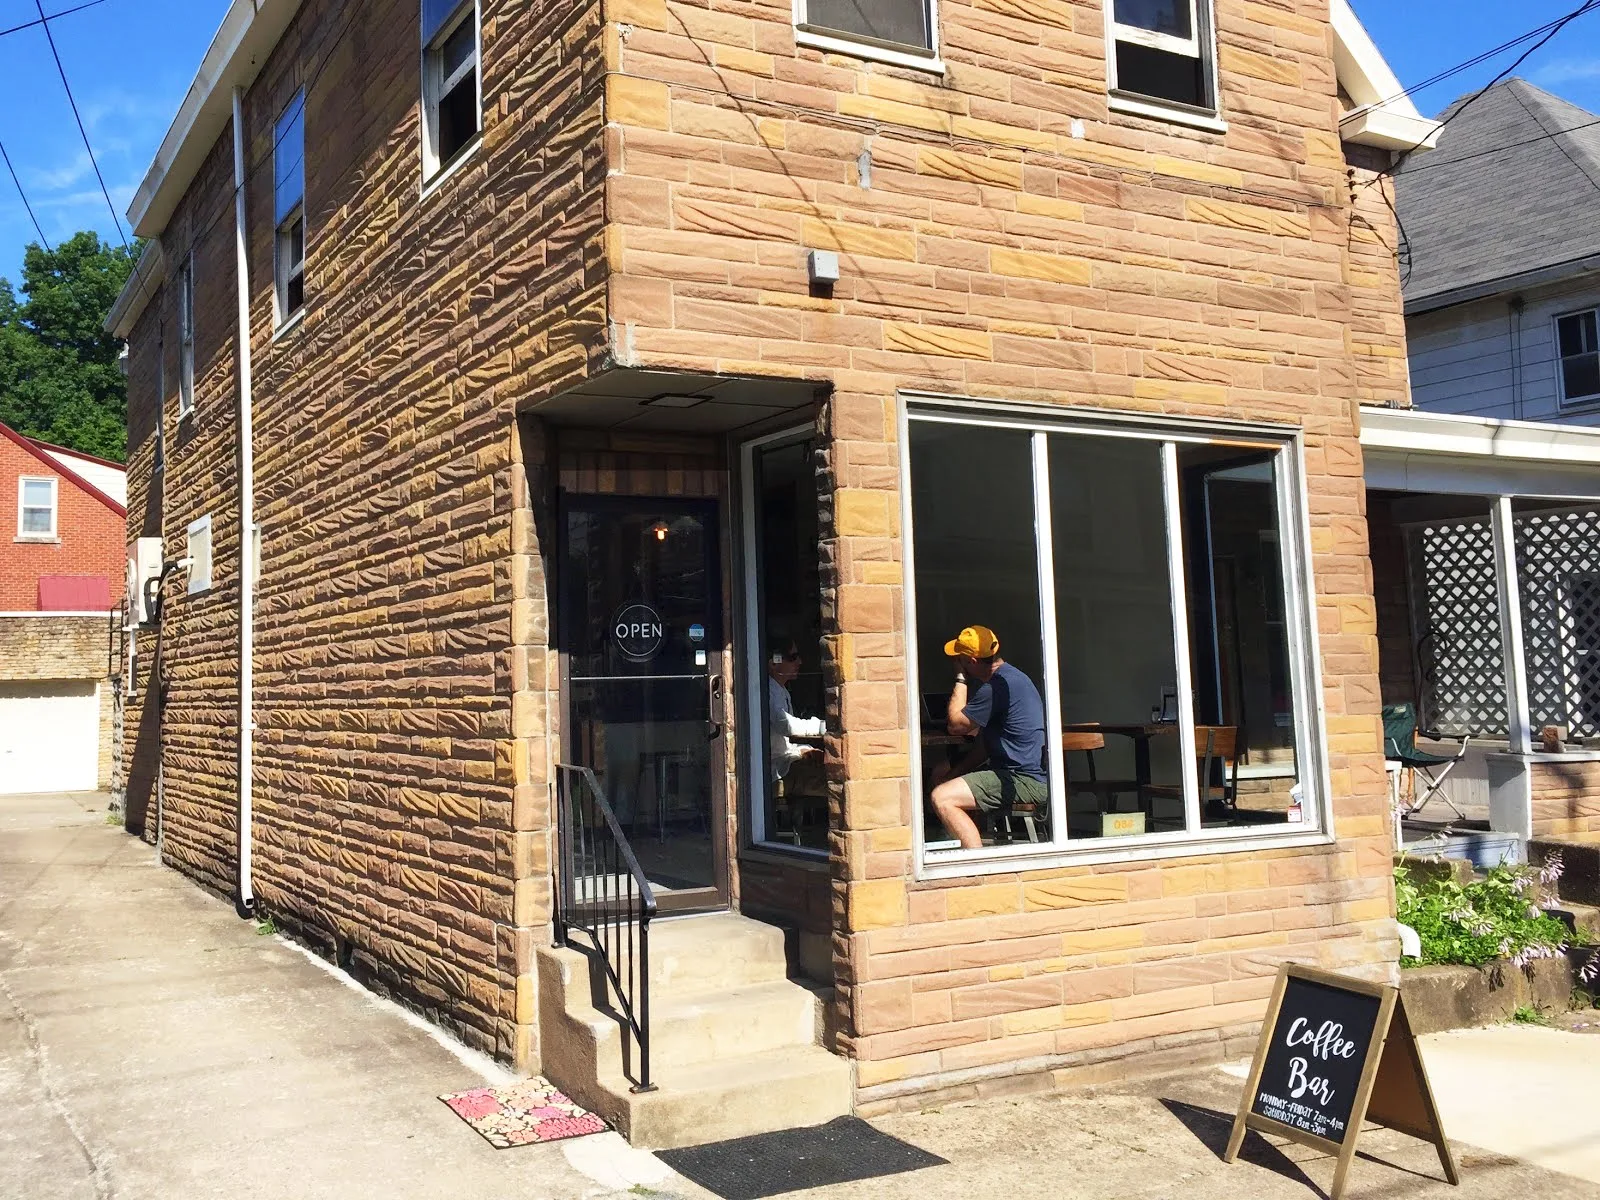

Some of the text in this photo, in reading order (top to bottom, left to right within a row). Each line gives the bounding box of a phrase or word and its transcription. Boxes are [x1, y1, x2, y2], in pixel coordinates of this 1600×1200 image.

[615, 623, 662, 638] OPEN
[1286, 1017, 1355, 1060] Coffee
[1288, 1057, 1335, 1106] Bar
